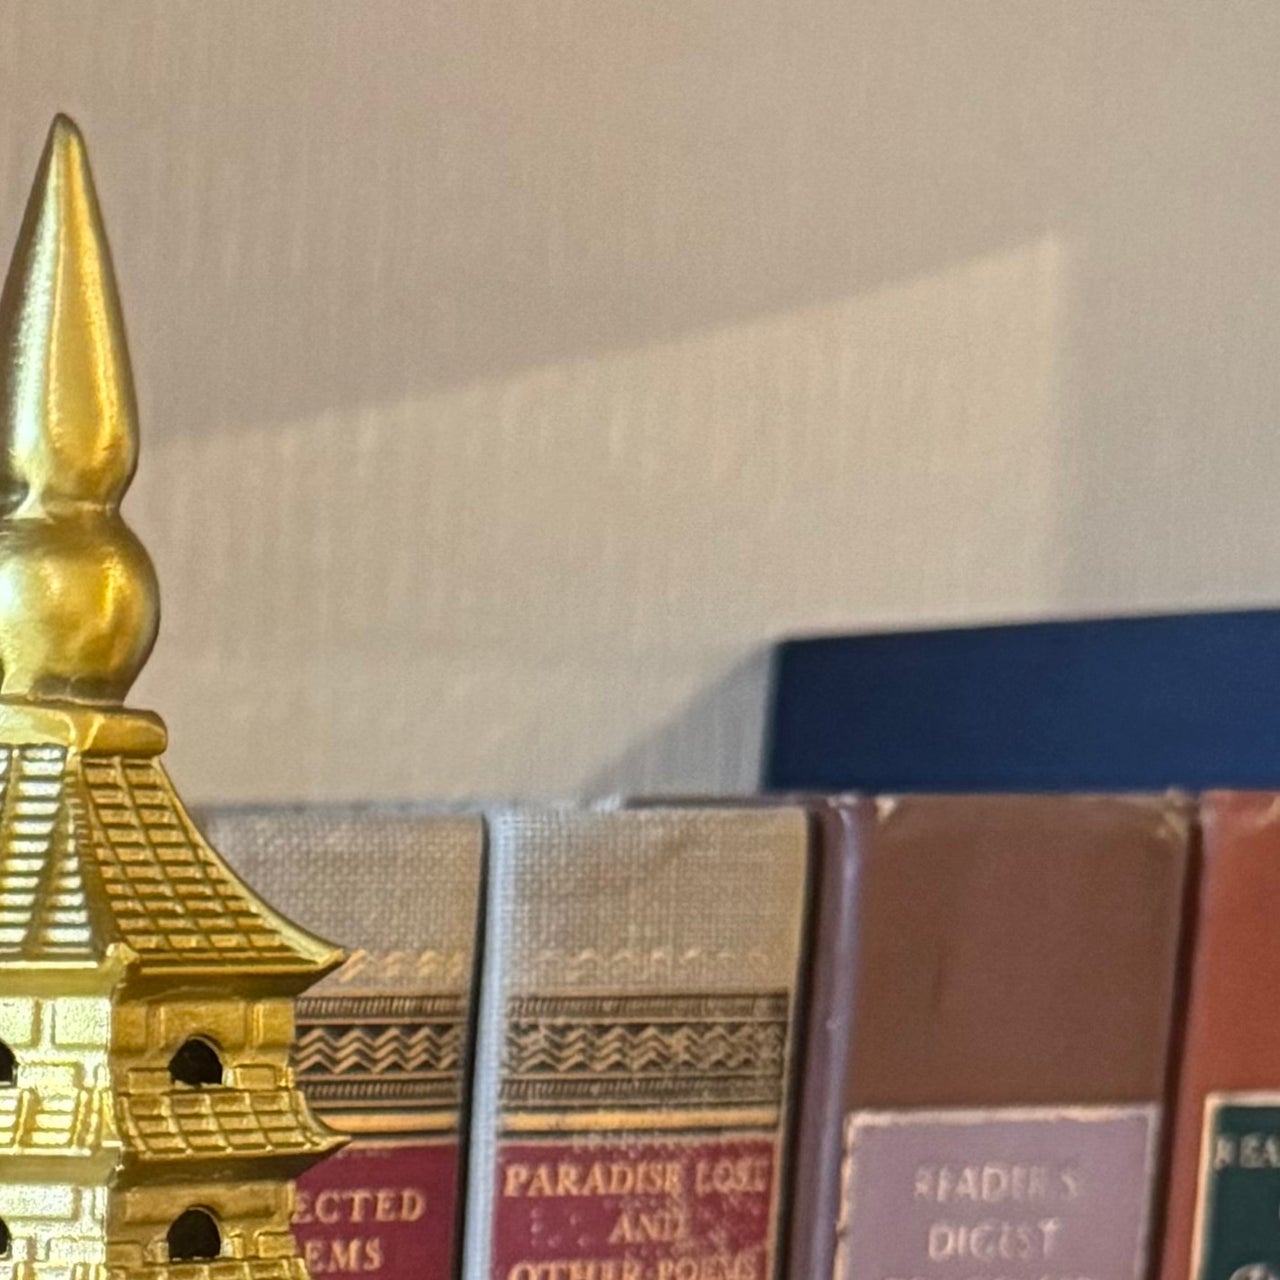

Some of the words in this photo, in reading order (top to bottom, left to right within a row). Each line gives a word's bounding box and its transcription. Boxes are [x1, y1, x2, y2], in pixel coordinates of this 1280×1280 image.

[503, 1160, 683, 1198] PARADISE
[695, 1157, 767, 1195] LOST
[291, 1189, 426, 1224] ECTED
[610, 1210, 690, 1245] AND
[304, 1238, 383, 1273] EMS
